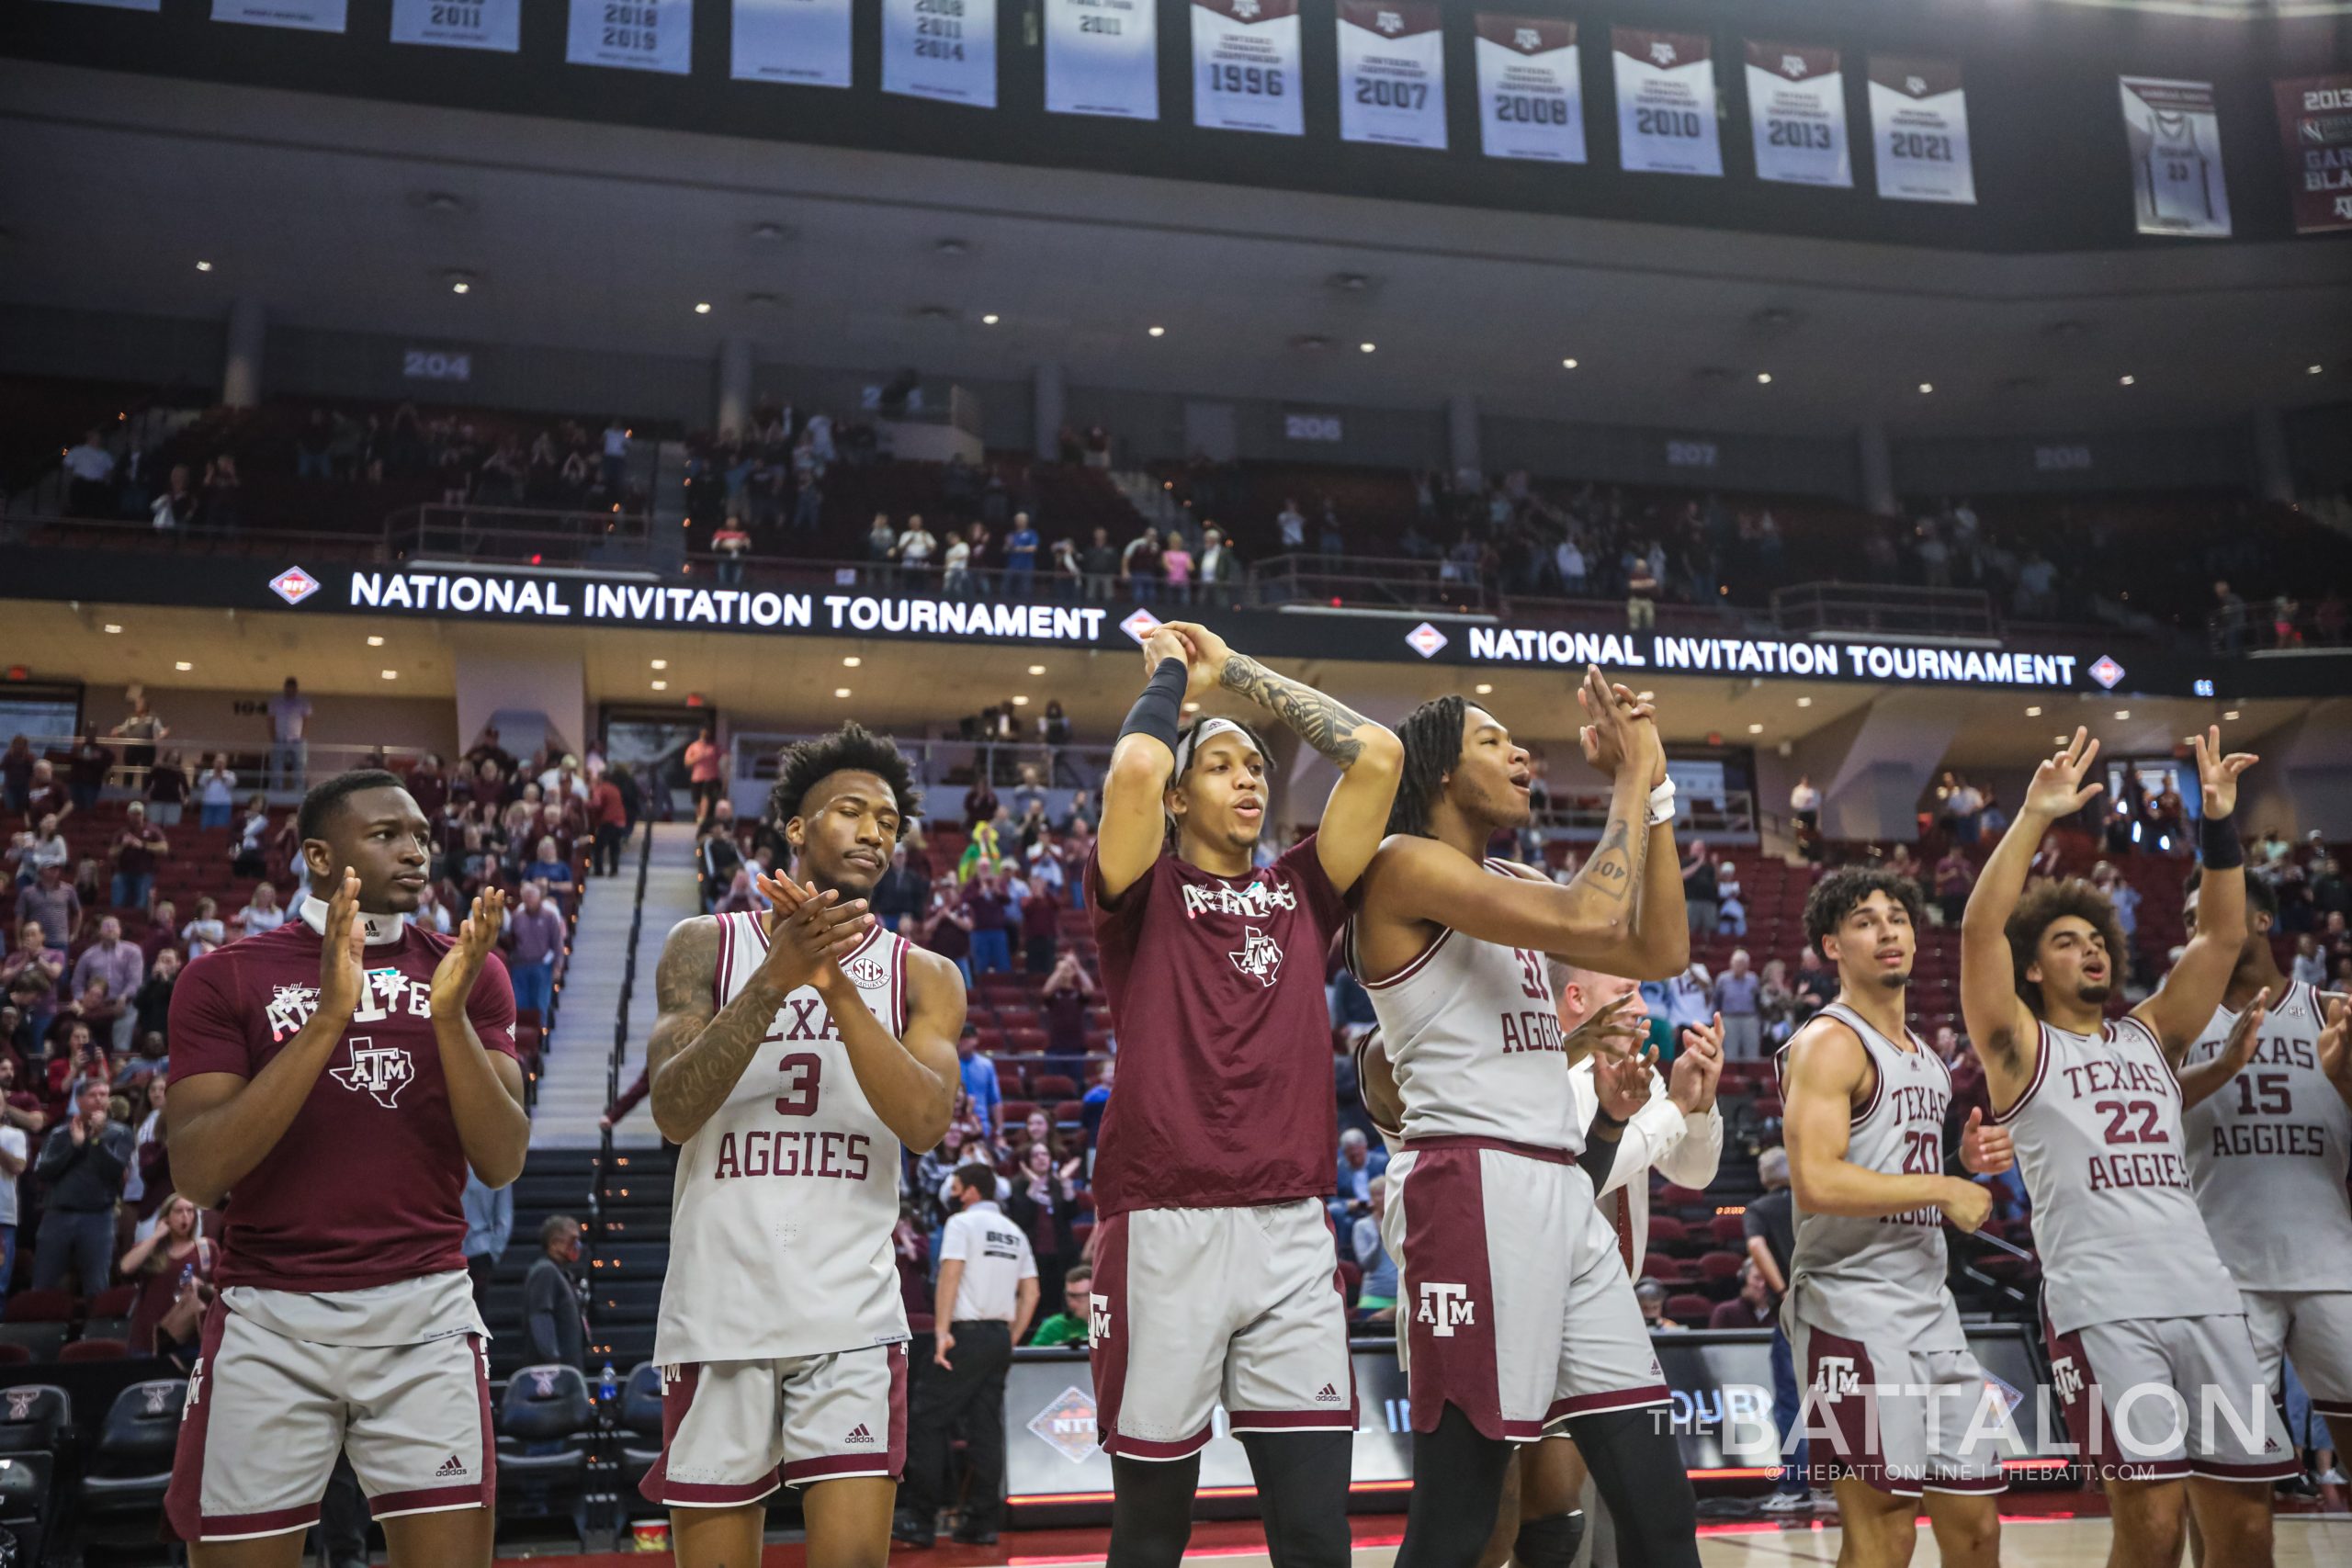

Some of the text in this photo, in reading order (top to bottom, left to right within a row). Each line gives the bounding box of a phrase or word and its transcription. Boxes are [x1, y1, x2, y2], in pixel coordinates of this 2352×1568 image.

[431, 5, 481, 28] 2011
[1210, 63, 1285, 97] 1996
[1354, 76, 1430, 111] 2007
[1495, 95, 1568, 126] 2008
[2302, 88, 2352, 111] 2013
[1635, 107, 1701, 139] 2010
[1767, 118, 1833, 150] 2013
[1890, 131, 1954, 163] 2021
[404, 352, 470, 379] 204
[350, 570, 1106, 641] NATIONAL INVITATION TOURNAMENT
[1469, 627, 2076, 685] NATIONAL INVITATION TOURNAMENT
[853, 958, 884, 982] SEC
[775, 1053, 822, 1117] 3
[2063, 1060, 2168, 1100] TEXAS
[2234, 1074, 2292, 1115] 15
[1891, 1085, 1946, 1127] TEXAS
[2095, 1100, 2169, 1145] 22
[715, 1131, 871, 1181] AGGIES
[1902, 1130, 1939, 1176] 20
[2212, 1123, 2324, 1157] AGGIES
[1314, 1394, 1341, 1403] adidas
[844, 1435, 875, 1444] adidas
[435, 1468, 468, 1478] adidas
